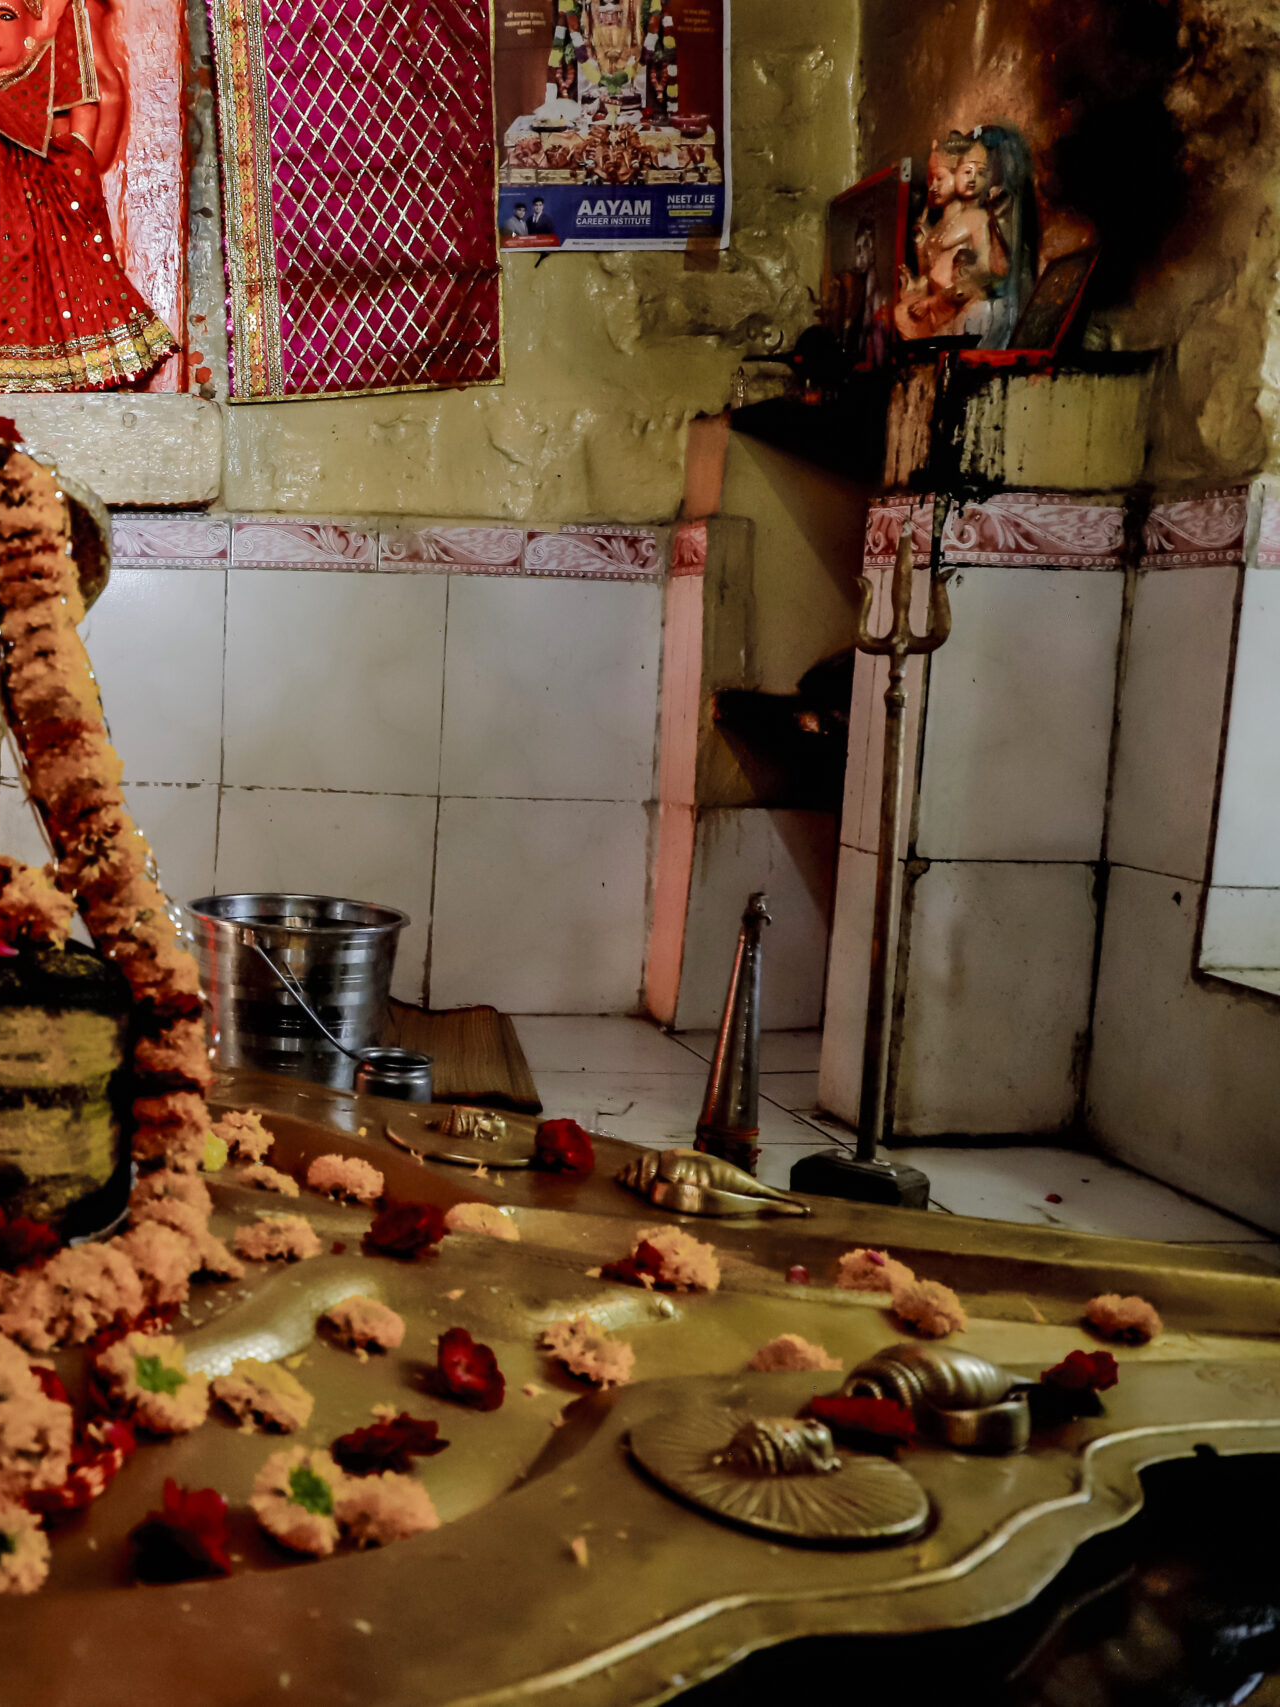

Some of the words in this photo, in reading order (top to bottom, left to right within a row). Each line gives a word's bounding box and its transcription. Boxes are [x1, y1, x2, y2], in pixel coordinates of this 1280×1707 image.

[667, 194, 692, 204] NEET
[699, 194, 715, 204] JEE
[577, 200, 651, 215] AAYAM
